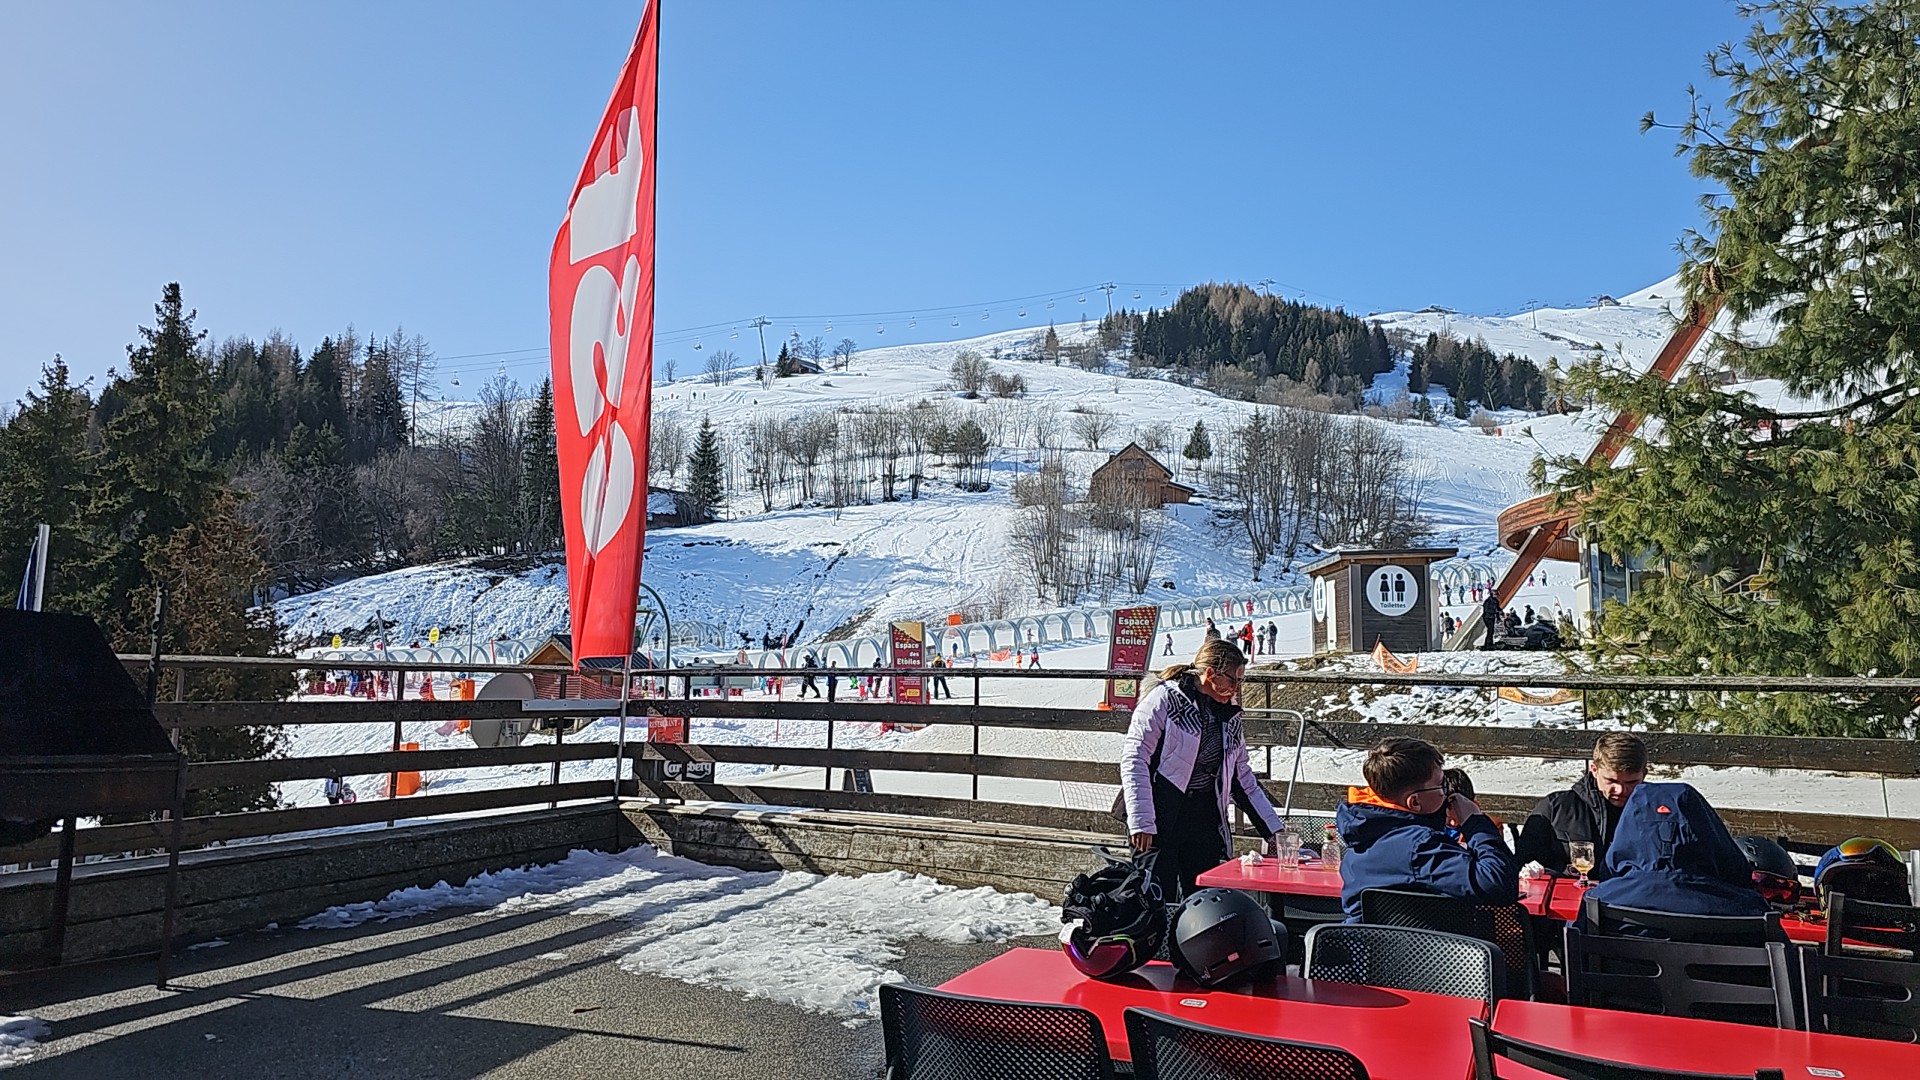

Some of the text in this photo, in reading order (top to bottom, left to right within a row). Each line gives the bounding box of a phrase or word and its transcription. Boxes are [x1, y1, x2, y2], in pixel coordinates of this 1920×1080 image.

[1118, 617, 1150, 626] Espace
[1115, 636, 1147, 646] Etoiles
[895, 642, 919, 650] Espace
[663, 760, 712, 779] Carsberg
